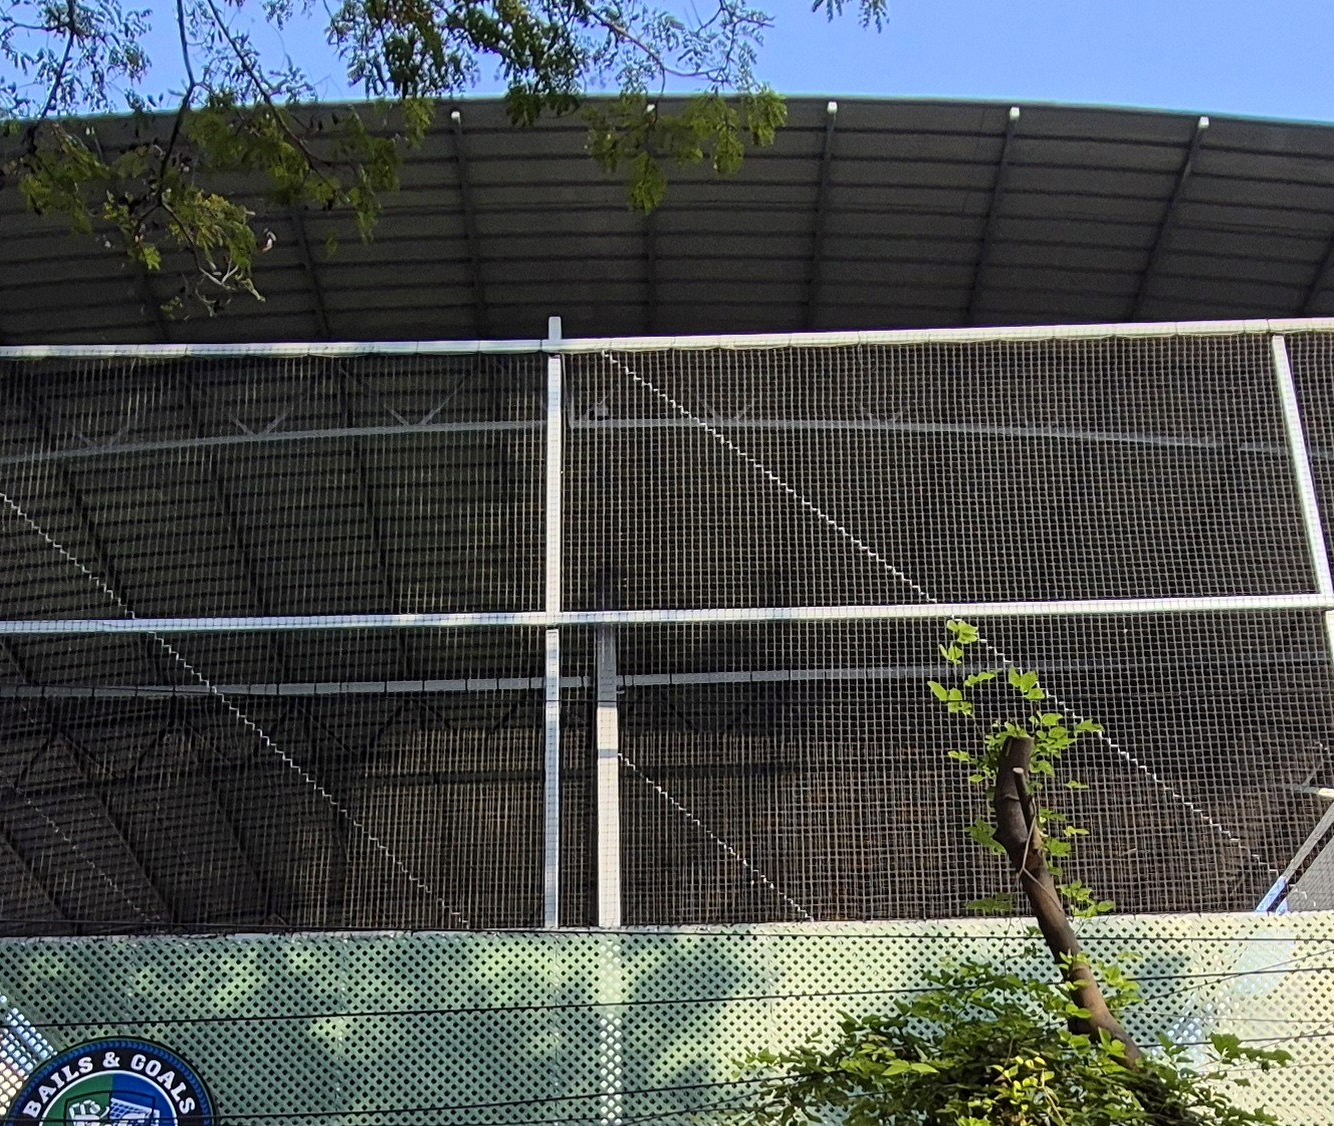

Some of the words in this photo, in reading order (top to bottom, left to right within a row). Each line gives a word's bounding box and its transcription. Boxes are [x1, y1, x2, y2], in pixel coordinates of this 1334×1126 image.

[23, 1056, 94, 1118] BAILS
[103, 1052, 120, 1068] &
[130, 1054, 196, 1115] GOALS
